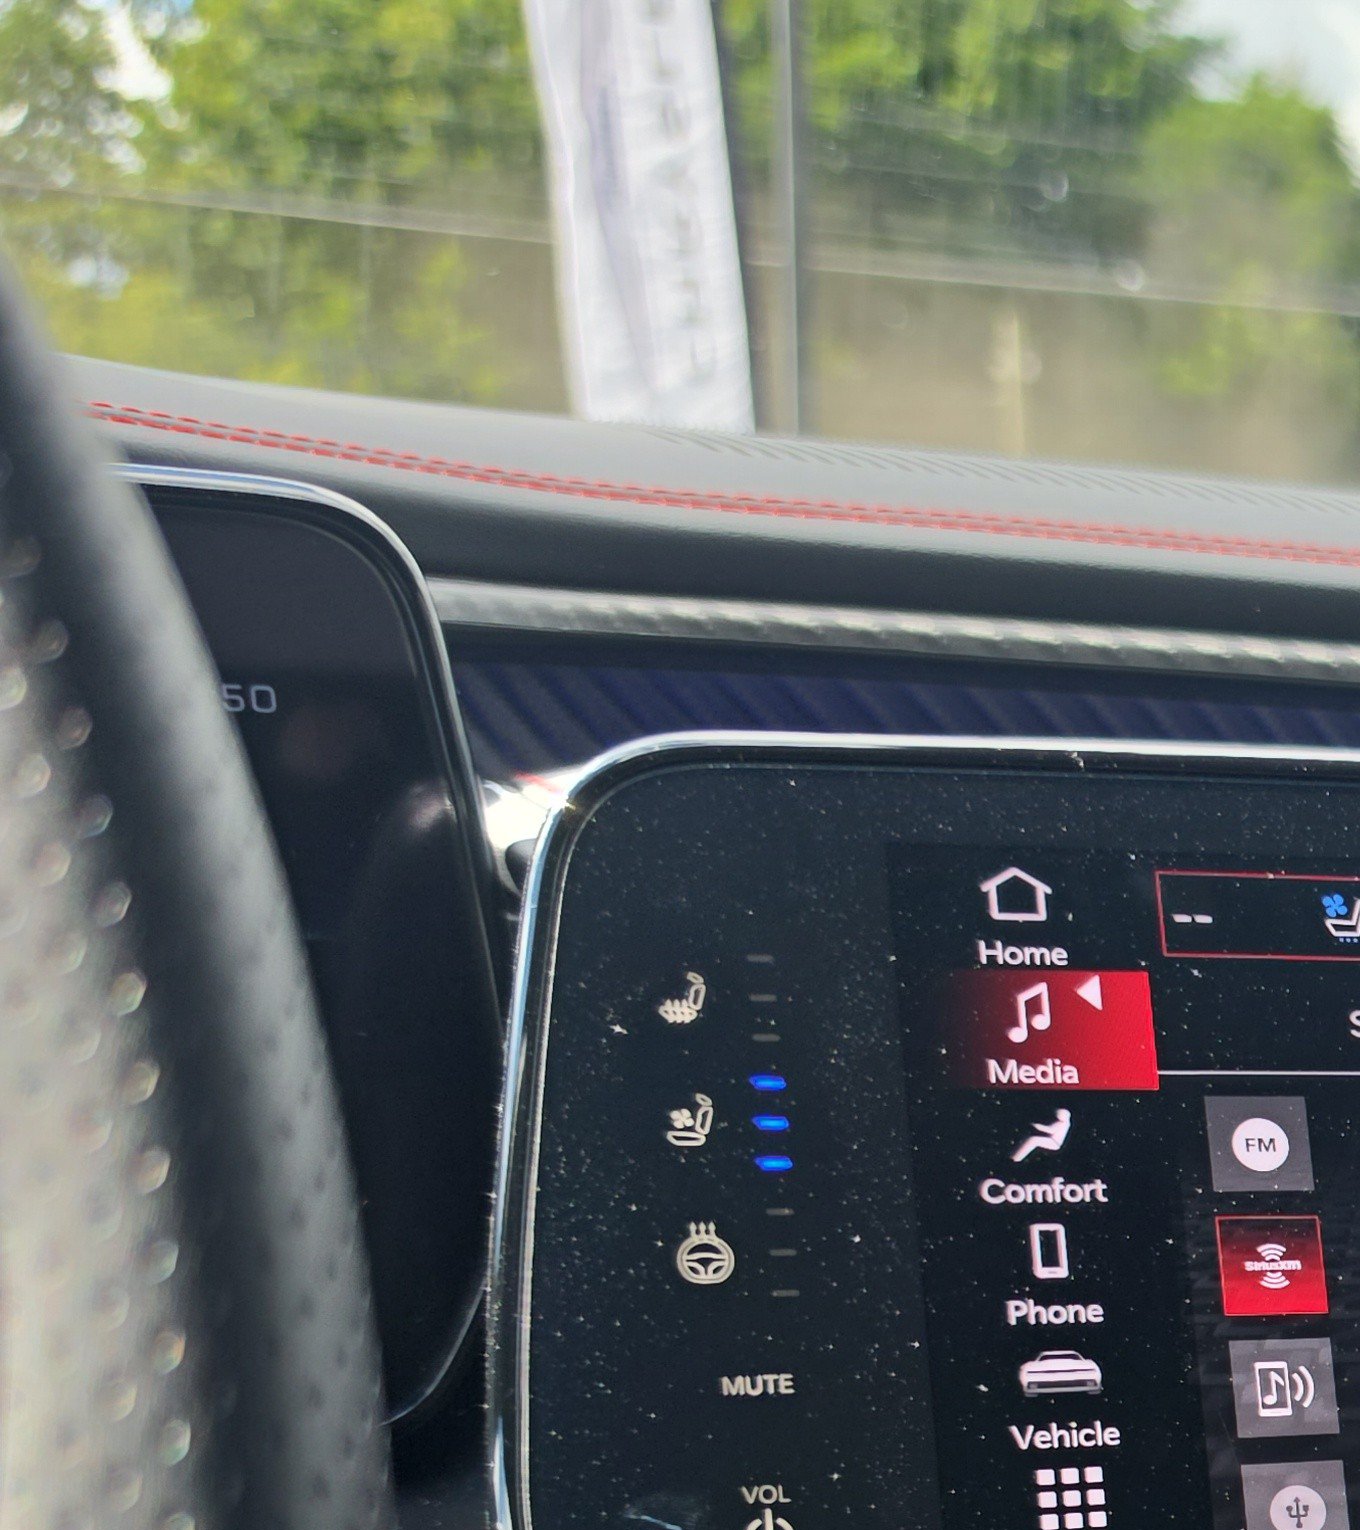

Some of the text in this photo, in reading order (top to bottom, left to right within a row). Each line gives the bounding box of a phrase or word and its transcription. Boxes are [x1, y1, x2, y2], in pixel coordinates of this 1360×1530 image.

[979, 940, 1068, 965] Home
[988, 1059, 1079, 1083] Media
[1244, 1137, 1277, 1153] FM
[980, 1177, 1108, 1204] Comfort
[1007, 1299, 1103, 1325] Phone
[722, 1374, 794, 1396] MUTE
[1010, 1421, 1120, 1449] Vehicle
[741, 1485, 791, 1504] VOL
